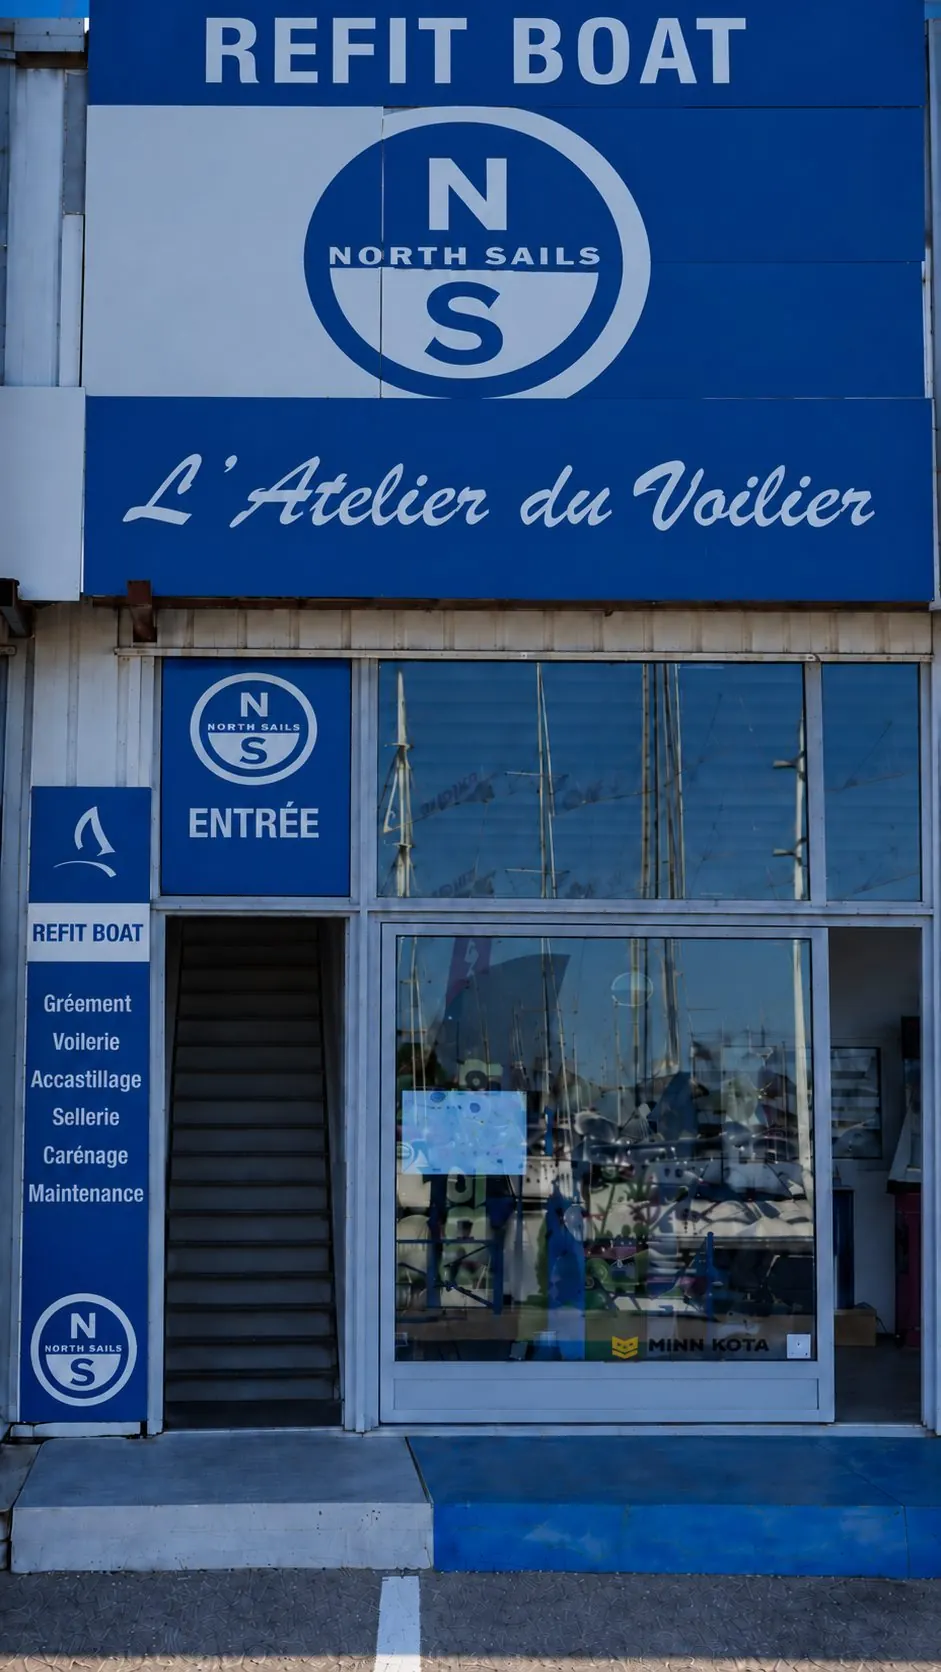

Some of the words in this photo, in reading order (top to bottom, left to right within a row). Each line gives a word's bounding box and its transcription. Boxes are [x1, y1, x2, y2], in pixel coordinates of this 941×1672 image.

[205, 17, 468, 84] REFIT
[513, 16, 747, 86] BOAT
[428, 157, 508, 231] N
[329, 246, 467, 266] NORTH
[485, 246, 600, 266] SAILS
[424, 281, 504, 366] S
[520, 464, 613, 528] du
[633, 460, 876, 532] Voilier
[240, 692, 269, 718] N
[207, 723, 255, 731] NORTH
[261, 723, 300, 731] SAILS
[239, 736, 268, 765] S
[189, 801, 320, 839] ENTRÉE
[32, 923, 88, 943] REFIT
[92, 923, 144, 943] BOAT
[43, 993, 132, 1013] Gréement
[52, 1032, 120, 1051] Voilerie
[30, 1069, 142, 1093] Accastillage
[52, 1107, 120, 1126] Sellerie
[42, 1145, 129, 1169] Carénage
[28, 1183, 144, 1203] Maintenance
[70, 1312, 96, 1339] N
[44, 1344, 85, 1352] NORTH
[89, 1344, 122, 1352] SAILS
[649, 1338, 703, 1352] MINN
[712, 1338, 769, 1352] KOTA
[70, 1357, 96, 1387] S
